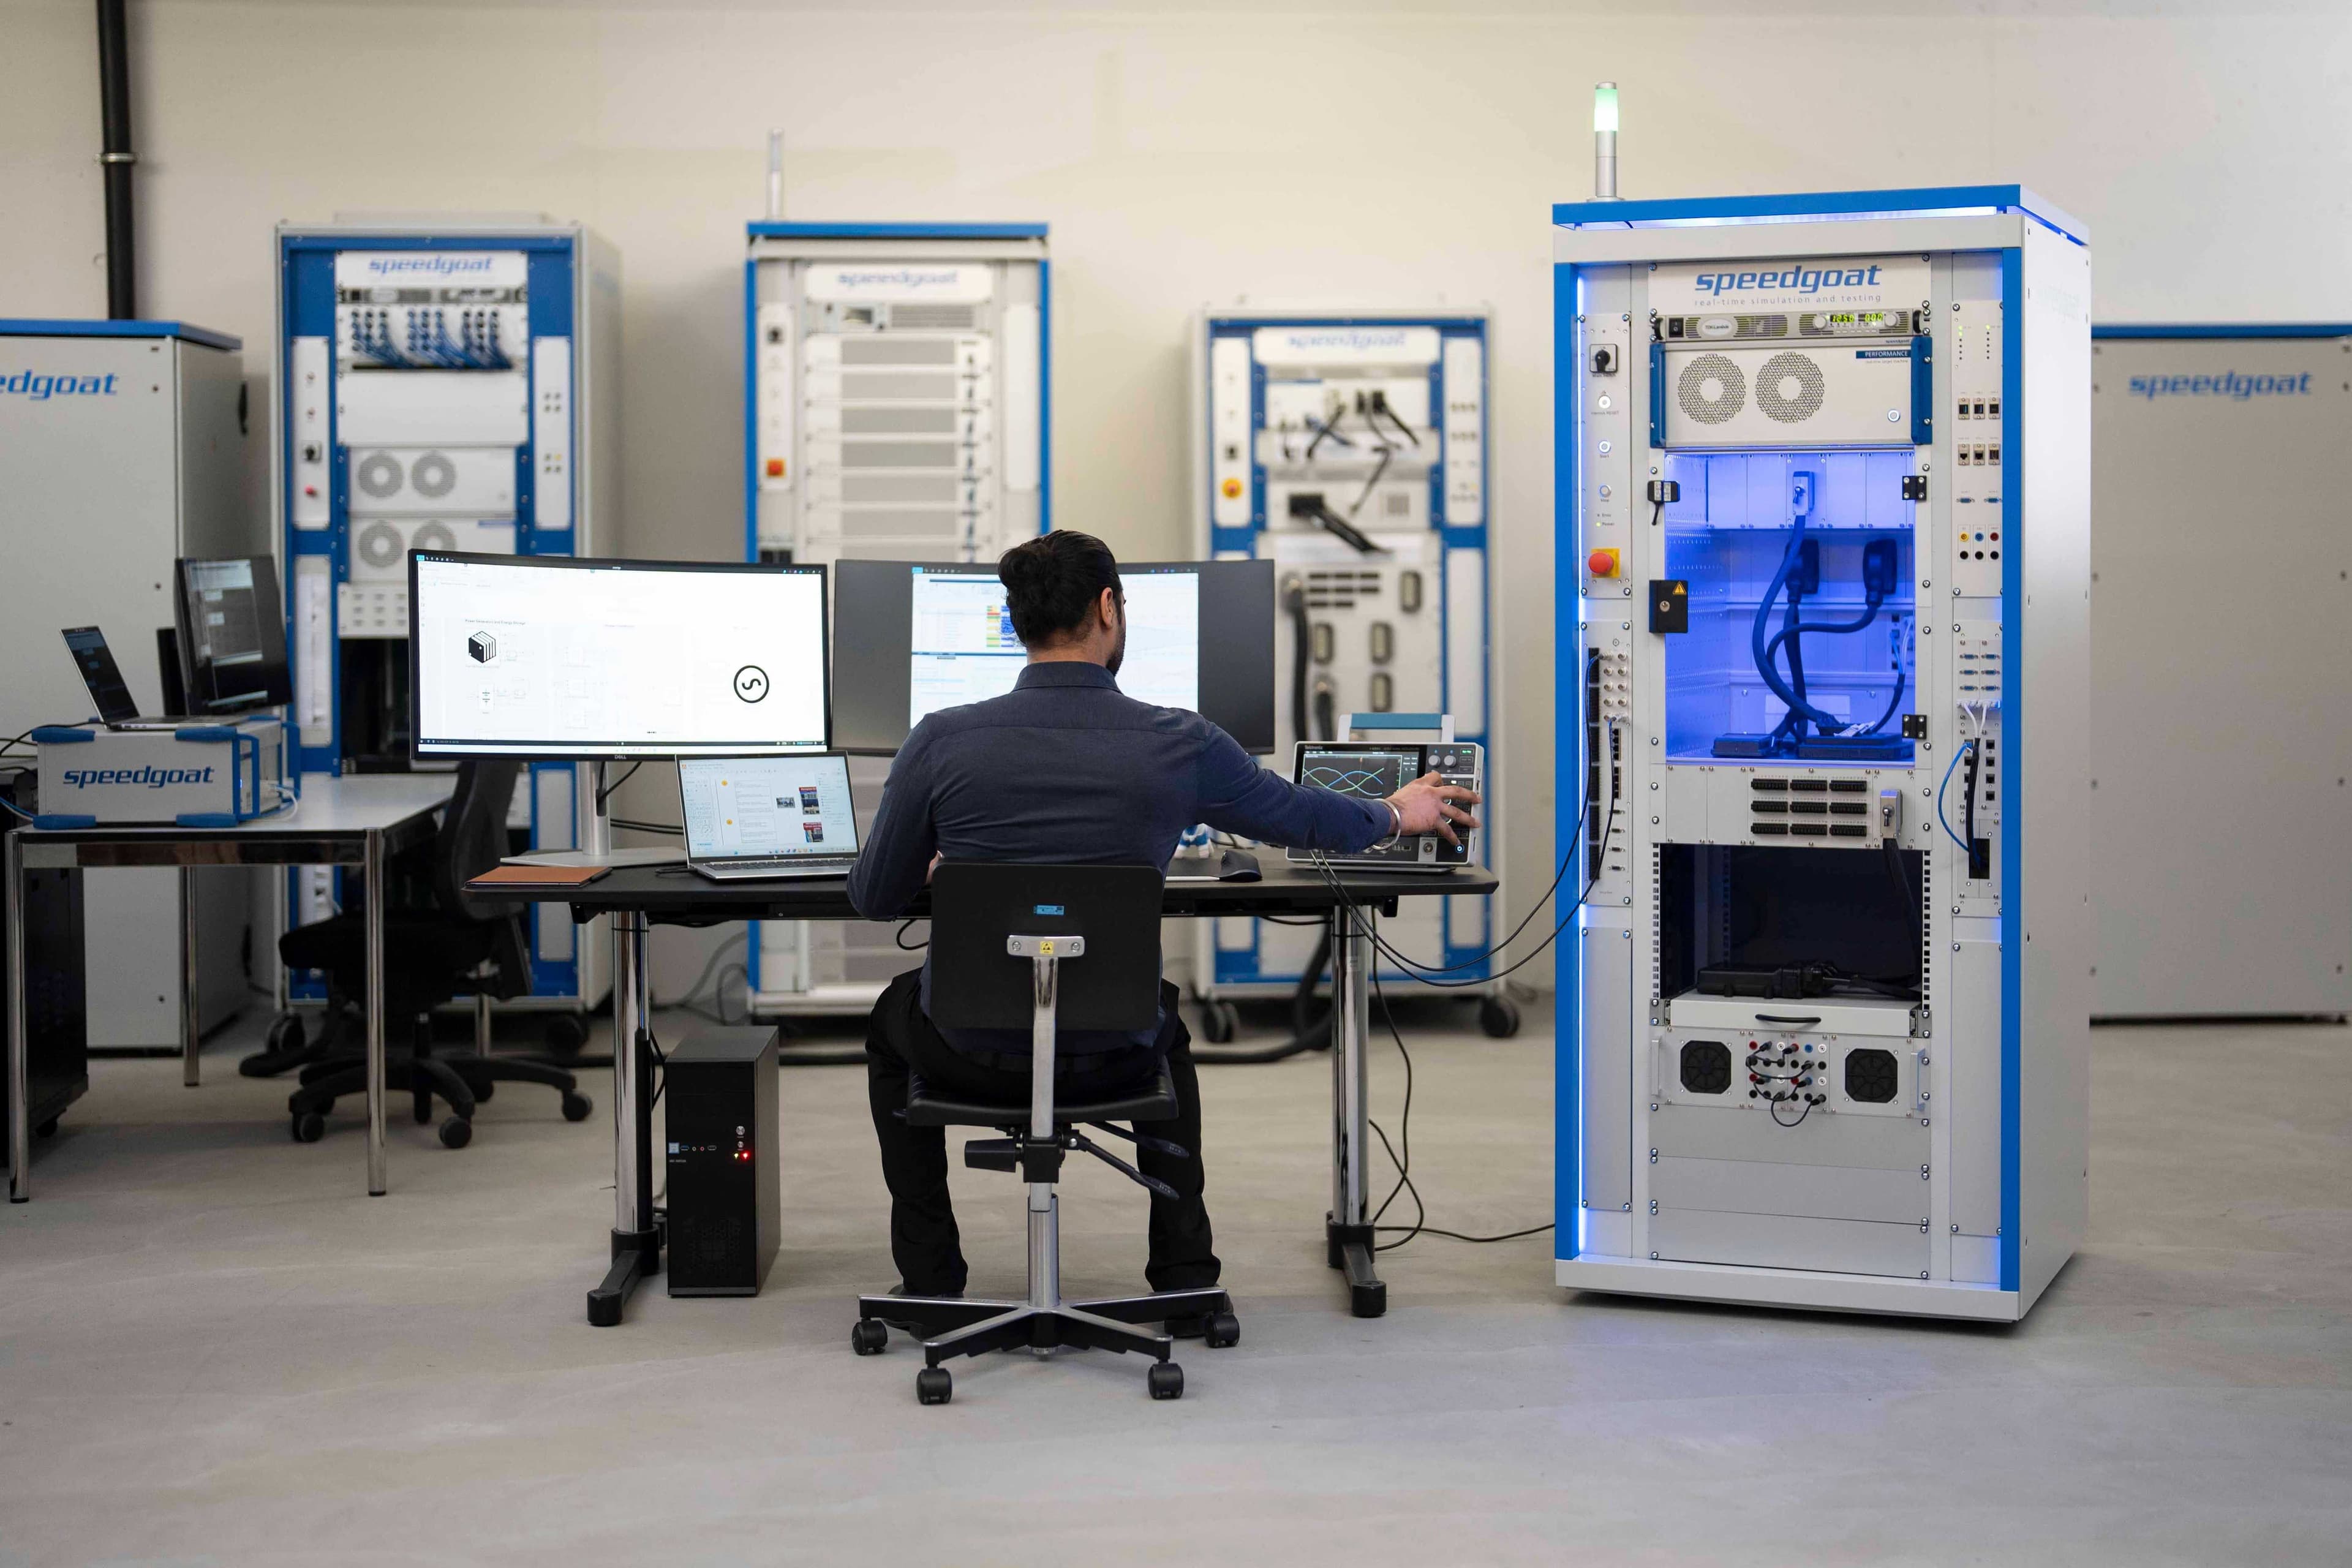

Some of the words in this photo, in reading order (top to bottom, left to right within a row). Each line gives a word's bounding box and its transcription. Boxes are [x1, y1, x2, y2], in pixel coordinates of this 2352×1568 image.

[369, 255, 492, 274] speedgoat
[1695, 265, 1882, 296] speedgoat
[1841, 294, 1881, 303] testing
[2128, 370, 2313, 401] speedgoat
[63, 766, 214, 789] speedgoat
